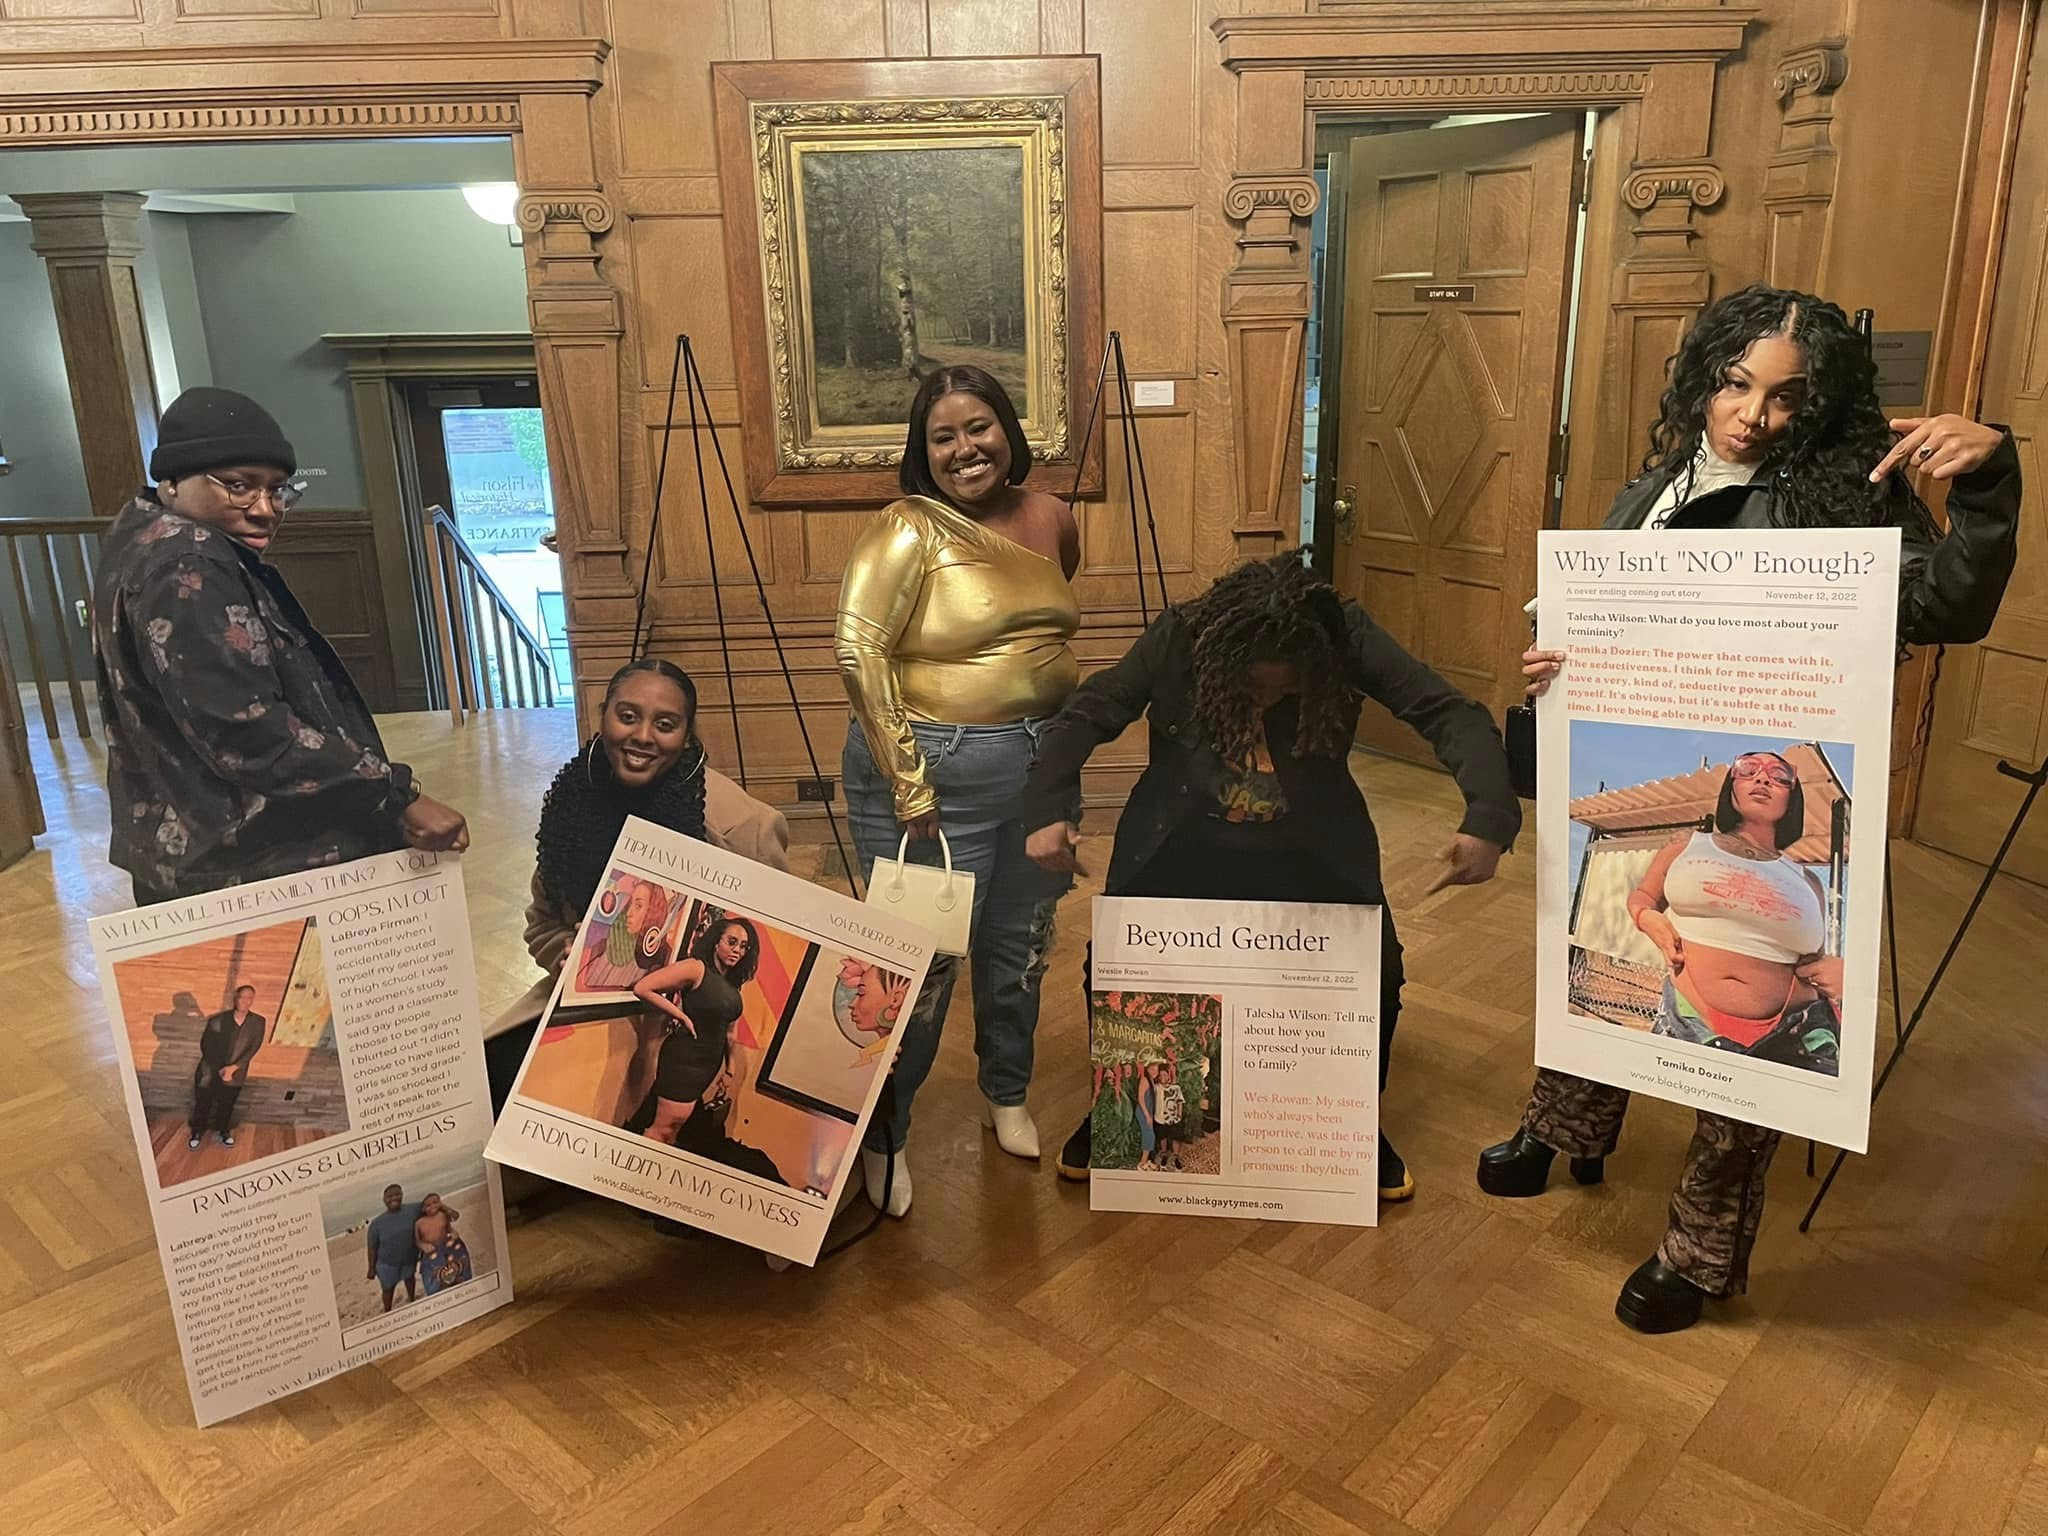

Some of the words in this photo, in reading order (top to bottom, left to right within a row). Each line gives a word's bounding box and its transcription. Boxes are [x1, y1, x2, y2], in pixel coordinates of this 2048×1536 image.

[1554, 550, 1609, 577] Why
[1618, 550, 1667, 572] Isn't
[1677, 550, 1742, 573] "NO"
[1753, 551, 1874, 581] Enough?
[1598, 587, 1626, 597] ending
[1627, 588, 1659, 598] coming
[1660, 589, 1676, 597] out
[1677, 589, 1701, 599] story
[1765, 590, 1814, 600] November
[1831, 592, 1856, 600] 2022
[1567, 611, 1605, 621] Talesha
[1607, 612, 1646, 623] Wilson:
[1648, 614, 1676, 624] What
[1679, 615, 1693, 624] do
[1694, 618, 1715, 627] you
[1717, 616, 1741, 626] love
[1743, 619, 1771, 627] most
[1773, 618, 1808, 629] about
[1810, 622, 1839, 631] your
[1567, 626, 1624, 639] femininity?
[1567, 643, 1607, 654] Tamika
[1609, 645, 1650, 656] Dozier:
[1652, 648, 1673, 658] The
[1676, 651, 1713, 661] power
[1716, 651, 1742, 661] that
[1744, 655, 1784, 664] comes
[1787, 655, 1817, 666] with
[1820, 656, 1833, 666] it.
[1566, 658, 1587, 668] The
[1680, 664, 1712, 676] think
[1715, 666, 1733, 676] for
[1736, 670, 1755, 678] me
[1567, 672, 1592, 683] have
[1633, 676, 1658, 687] kind
[1679, 680, 1736, 692] seductive
[1738, 686, 1778, 695] power
[1780, 687, 1816, 698] about
[1608, 689, 1626, 699] It's
[1678, 695, 1697, 704] but
[1700, 696, 1719, 706] it's
[1722, 698, 1760, 709] subtle
[1762, 703, 1774, 711] at
[1778, 703, 1799, 712] the
[1802, 705, 1836, 715] same
[102, 915, 160, 940] WHAT
[168, 905, 213, 925] WILL
[216, 893, 253, 915] THE
[255, 881, 314, 908] FAMILY
[321, 866, 376, 890] THINK?
[412, 884, 447, 904] OUT
[330, 925, 377, 943] LaBreya
[333, 936, 392, 957] remember
[395, 927, 426, 942] when
[1126, 923, 1221, 953] Beyond
[1231, 926, 1329, 951] Gender
[336, 947, 402, 971] accidentally
[403, 937, 436, 953] outed
[338, 965, 375, 984] myself
[376, 963, 394, 974] my
[397, 954, 429, 969] senior
[431, 948, 453, 962] year
[1123, 967, 1148, 975] Rowan
[340, 985, 352, 998] of
[352, 980, 379, 995] high
[426, 964, 448, 975] was
[1281, 973, 1320, 982] November
[1334, 975, 1354, 983] 2022
[1244, 1007, 1284, 1019] Talesha
[1288, 1009, 1330, 1021] Wilson:
[1334, 1011, 1354, 1022] Tell
[1358, 1014, 1375, 1023] me
[1243, 1023, 1274, 1035] about
[1278, 1025, 1302, 1036] how
[1304, 1029, 1324, 1040] you
[1243, 1042, 1298, 1055] expressed
[1301, 1046, 1326, 1056] your
[1330, 1045, 1372, 1059] identity
[1243, 1059, 1255, 1068] to
[1258, 1058, 1296, 1072] family?
[1655, 1056, 1695, 1073] Tamika
[1698, 1066, 1732, 1082] Dozier
[1243, 1091, 1268, 1103] Wes
[1316, 1095, 1334, 1108] My
[1630, 1071, 1756, 1109] www.blackgaytymes.com
[1242, 1108, 1275, 1120] who's
[1277, 1110, 1312, 1125] always
[1316, 1111, 1342, 1124] been
[1306, 1131, 1329, 1140] was
[1331, 1129, 1348, 1141] the
[1352, 1131, 1375, 1142] first
[1242, 1142, 1280, 1155] person
[1282, 1146, 1294, 1156] to
[1296, 1145, 1316, 1157] call
[1319, 1146, 1336, 1157] me
[1339, 1146, 1353, 1160] by
[1355, 1151, 1375, 1162] my
[192, 1162, 312, 1213] RAINBOWS
[317, 1155, 332, 1172] &
[336, 1115, 455, 1165] UMBRELLAS
[521, 1119, 588, 1154] FINDING
[594, 1141, 670, 1180] VALIDITY
[668, 1168, 683, 1188] IN
[692, 1175, 718, 1197] MY
[719, 1187, 800, 1226] GAYNESS
[1242, 1159, 1297, 1172] pronouns:
[592, 1174, 714, 1223] www.BlackGayTymes.com
[1158, 1195, 1283, 1210] www.blackgaytymes.com
